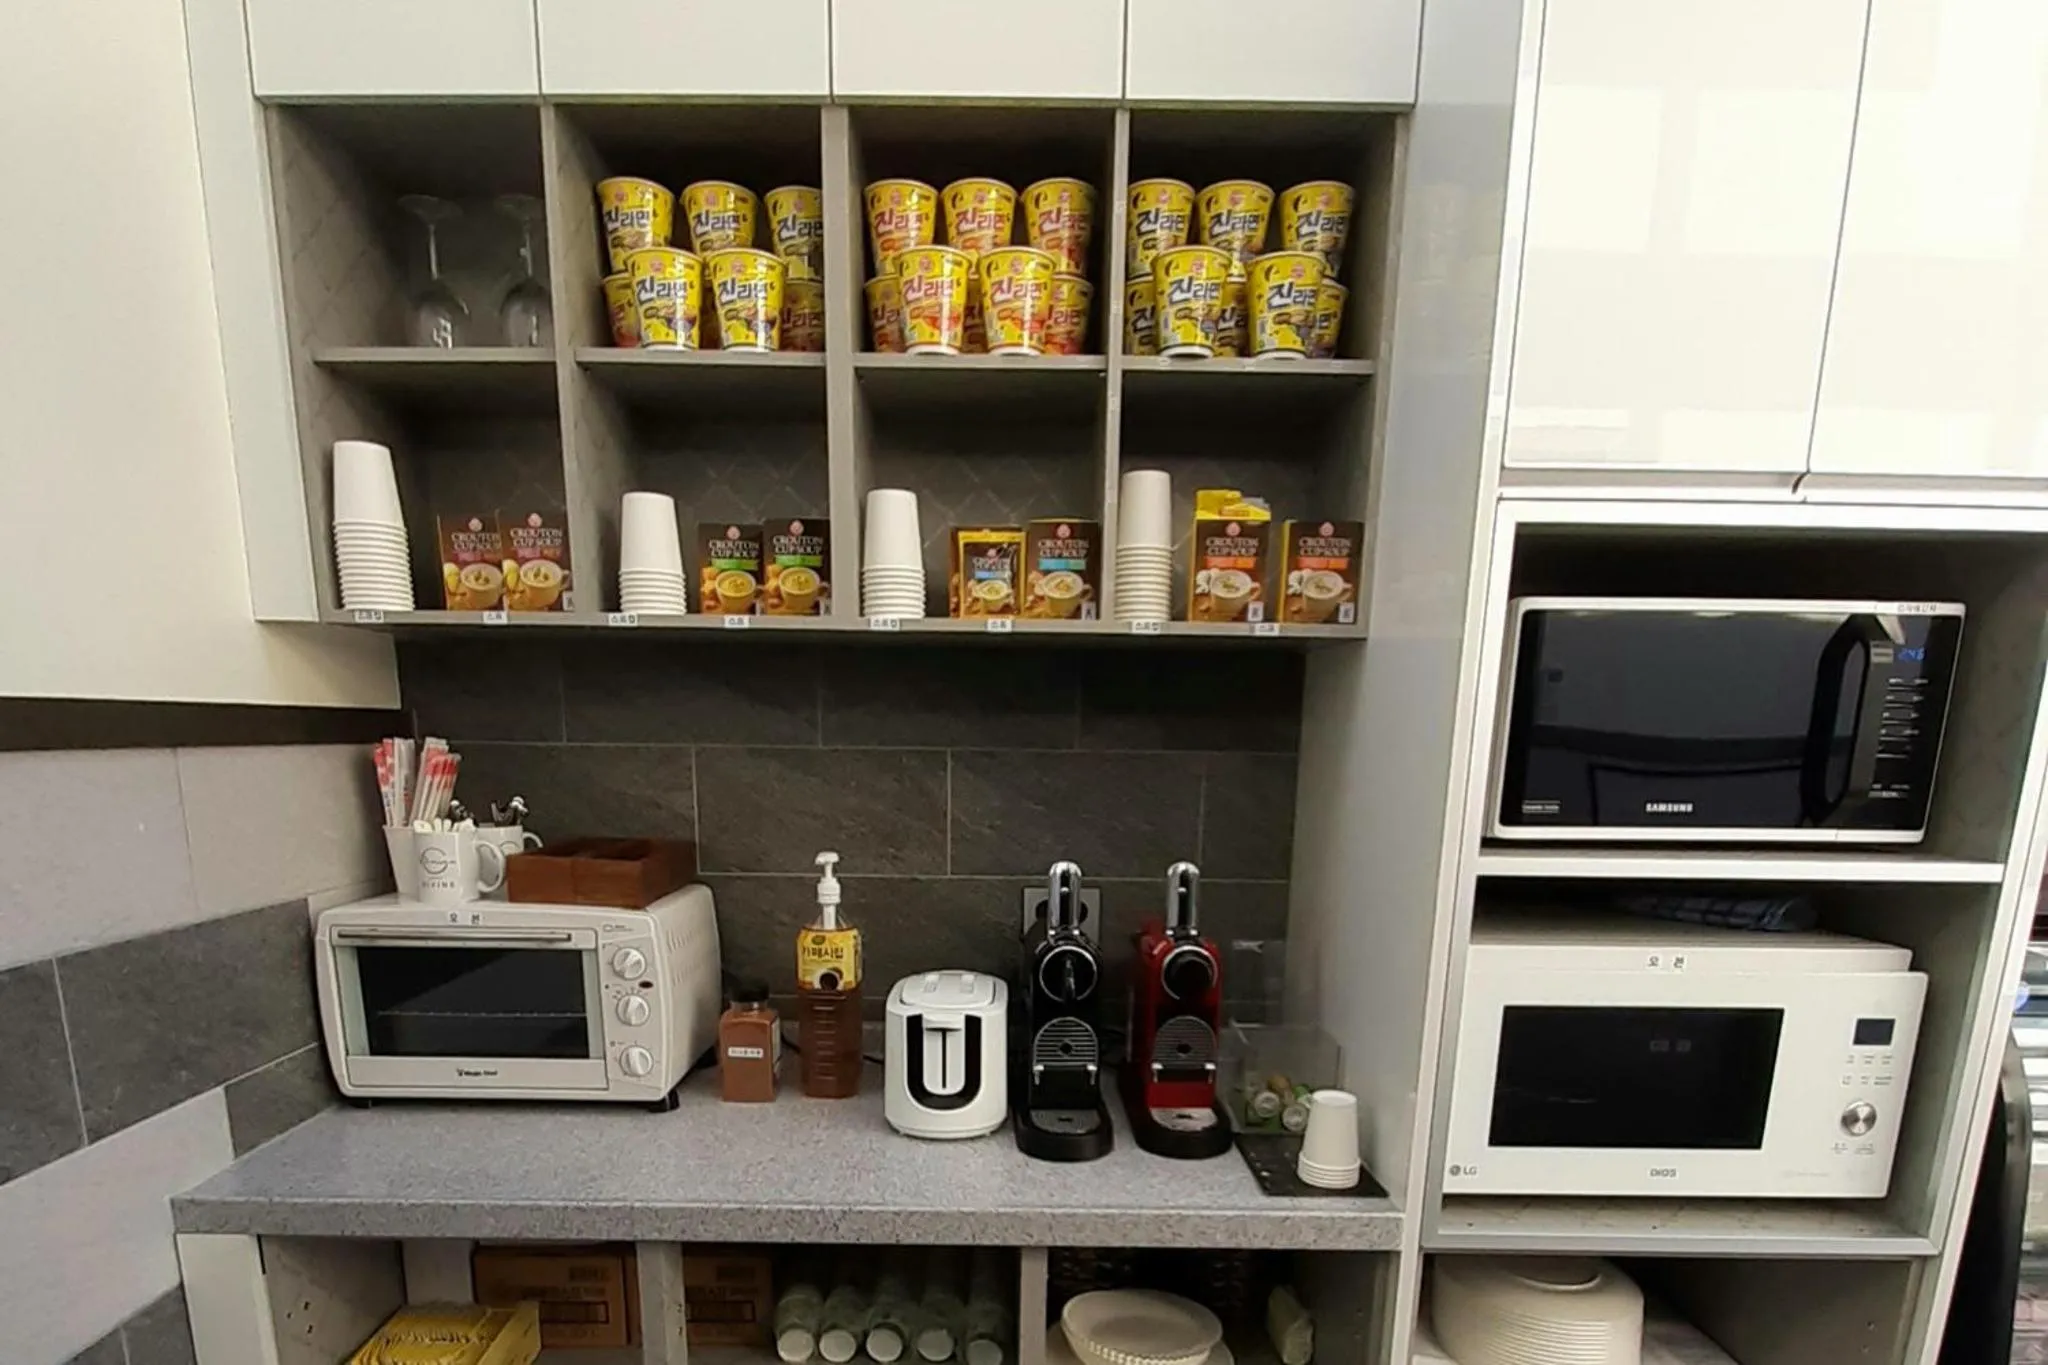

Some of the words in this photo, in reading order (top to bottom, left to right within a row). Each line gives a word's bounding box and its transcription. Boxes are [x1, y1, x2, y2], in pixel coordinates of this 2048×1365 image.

[956, 208, 1006, 235] 진라면
[1136, 207, 1185, 236] 진라면
[1209, 208, 1260, 238] 진라면
[1296, 209, 1347, 239] 진라면
[1168, 275, 1221, 306] 진라면
[1267, 281, 1317, 309] 진라면
[1646, 803, 1693, 812] SAMSUNG
[1463, 1167, 1477, 1175] LG
[1650, 1168, 1677, 1177] DIOS
